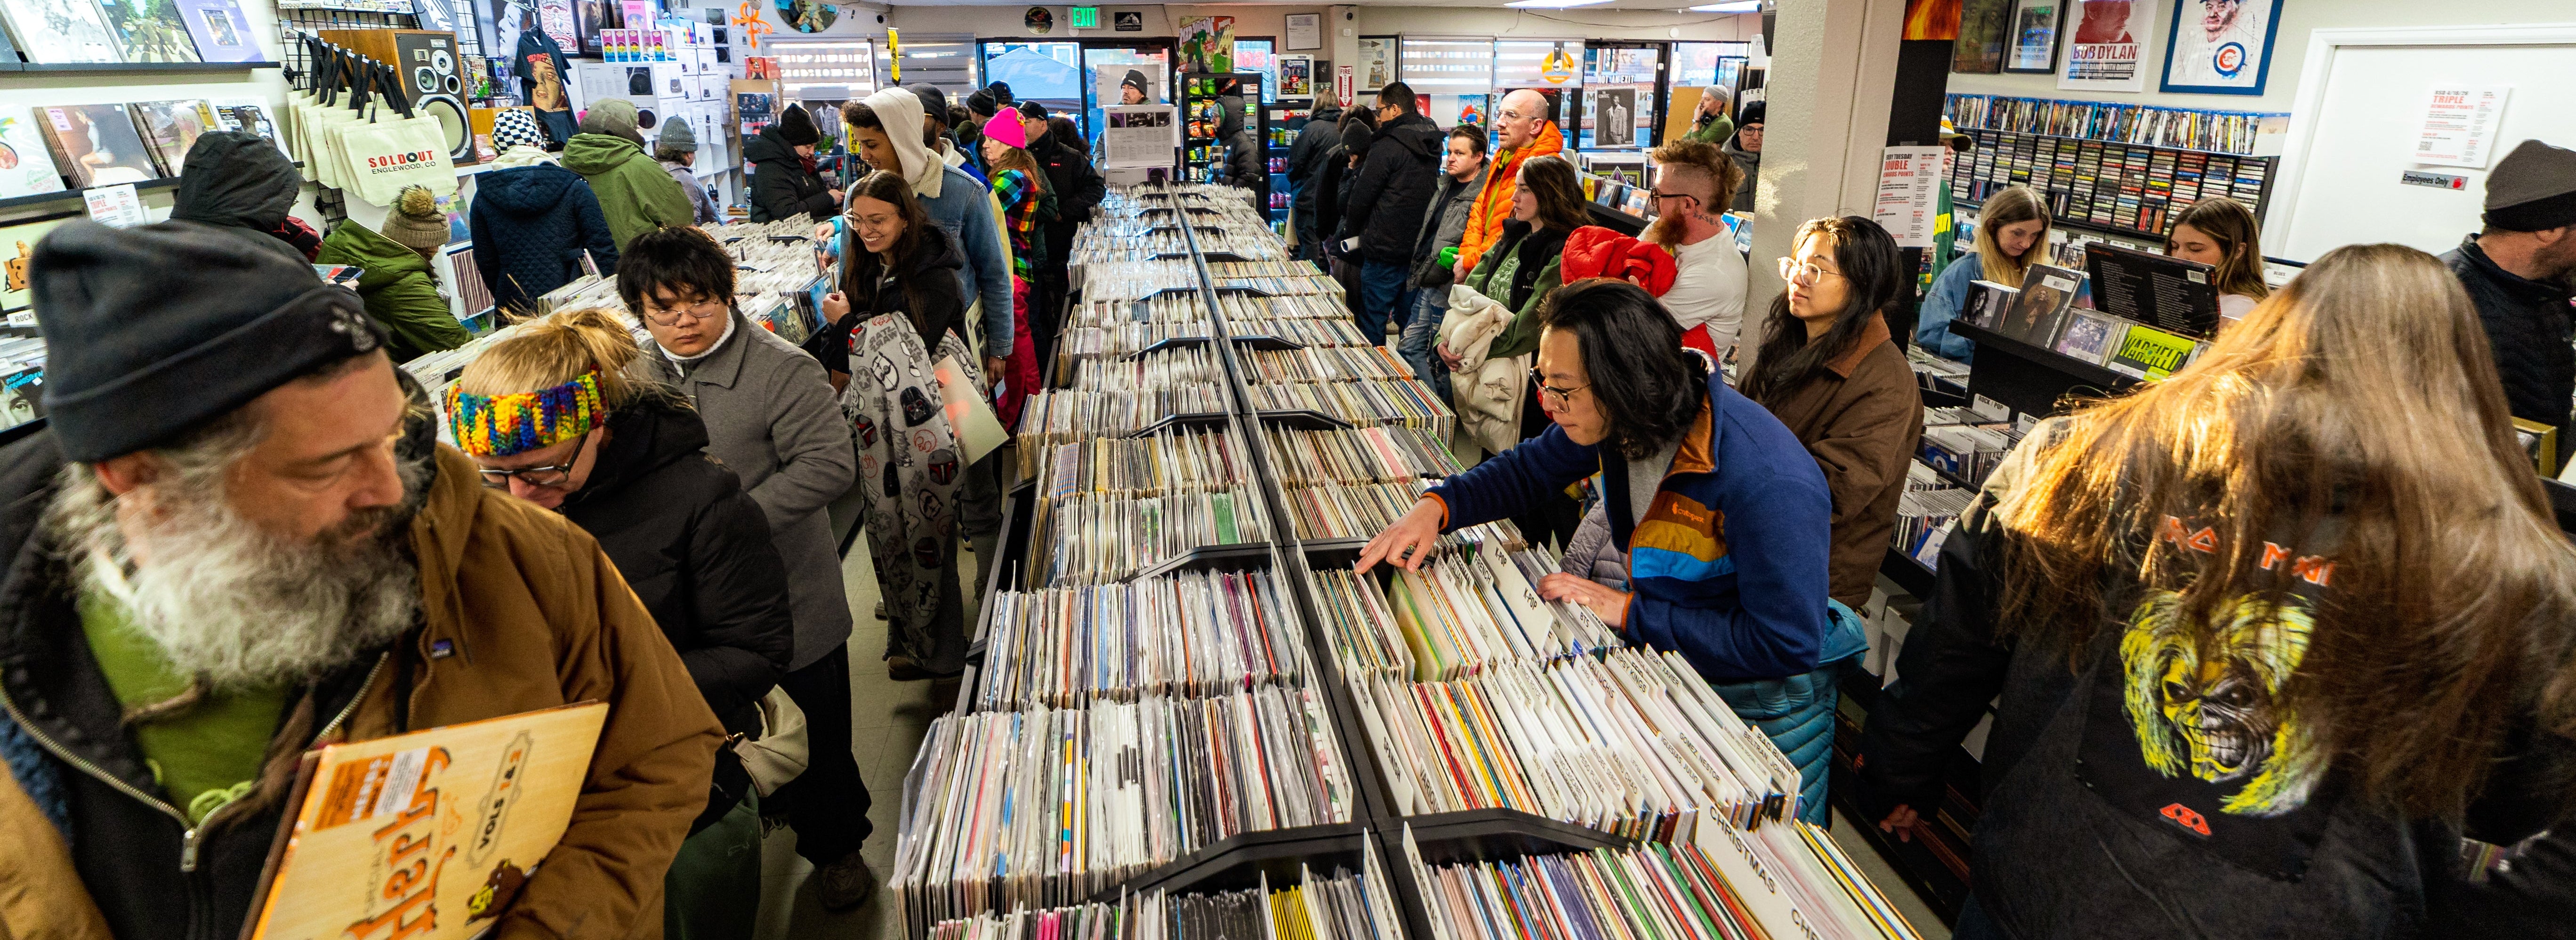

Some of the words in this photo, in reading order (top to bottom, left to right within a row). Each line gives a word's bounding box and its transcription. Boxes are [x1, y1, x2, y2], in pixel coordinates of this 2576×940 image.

[1073, 8, 1096, 27] EXIT
[2073, 46, 2095, 59] BOB
[2097, 45, 2137, 60] DYLAN
[1597, 75, 1609, 84] NOT
[1610, 75, 1619, 84] AN
[1620, 75, 1635, 84] EXIT
[2433, 96, 2465, 104] TRIPLE
[371, 163, 424, 175] ENGLEWOOD,
[1884, 160, 1908, 170] DOUBLE
[2402, 174, 2433, 184] Employees
[2434, 177, 2450, 187] Only
[15, 313, 34, 323] ROCK
[1978, 396, 1990, 405] ROCK
[1994, 402, 2004, 411] POP
[1449, 558, 1464, 586] ITALIAN
[1454, 555, 1472, 587] GERMAN
[1473, 555, 1491, 585] FRENCH
[1494, 546, 1507, 567] K-POP
[1523, 587, 1538, 611] K-POP
[1579, 612, 1589, 628] BTS
[1487, 671, 1500, 697] SELENA
[1588, 660, 1598, 677] KALI
[1598, 674, 1615, 699] UCHIS
[1615, 650, 1630, 673] GIPSY
[1629, 669, 1647, 693] KINGS
[1646, 648, 1662, 670] CUGAT,
[1662, 665, 1679, 688] XAVIER
[1354, 670, 1369, 709] SPANISH
[1383, 736, 1401, 783] SPANISH
[1590, 744, 1606, 770] MENDES,
[1606, 767, 1621, 791] SERGIO
[1661, 736, 1683, 767] IGLESIAS,
[1683, 762, 1698, 783] JULIO
[1679, 732, 1699, 757] GOMEZ,
[1699, 756, 1720, 783] NESTOR
[1743, 730, 1769, 762] BELTRAN,
[1770, 760, 1786, 780] JOHN
[1757, 732, 1771, 750] BAD
[1772, 748, 1795, 776] BUNNY
[1579, 752, 1590, 772] PESO
[1590, 770, 1605, 794] PLUMA
[1612, 750, 1624, 774] MANU
[1624, 771, 1638, 795] CHAO
[477, 799, 505, 850] VOLS
[1709, 805, 1776, 894] CHRISTMAS
[1412, 852, 1438, 932] CHRISTMAS
